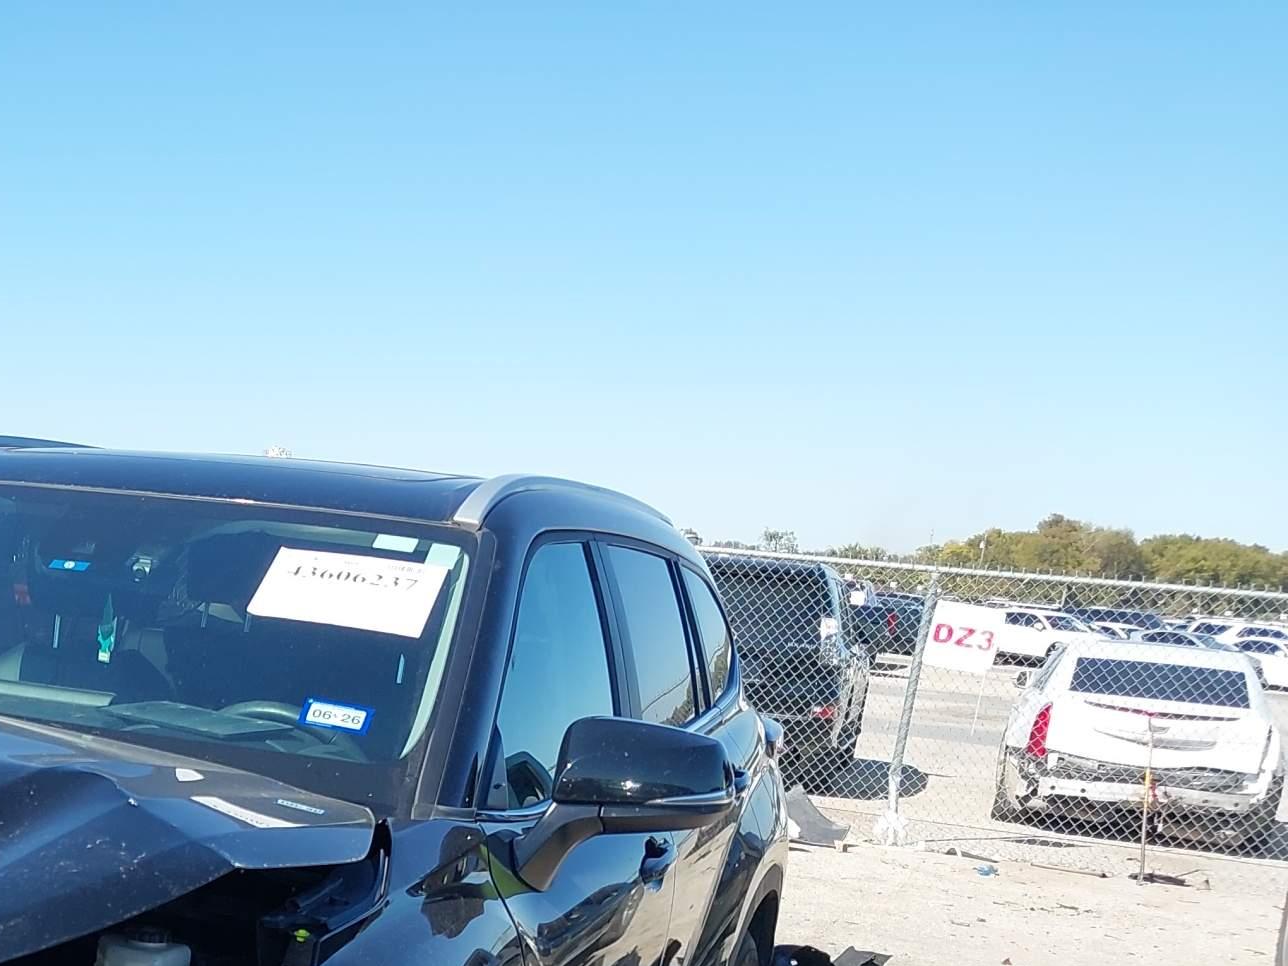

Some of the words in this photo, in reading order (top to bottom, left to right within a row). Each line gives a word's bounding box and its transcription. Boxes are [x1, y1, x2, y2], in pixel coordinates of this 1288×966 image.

[288, 564, 419, 591] 43606237
[933, 623, 994, 651] DZ3
[312, 708, 332, 720] 06
[340, 713, 361, 725] 26
